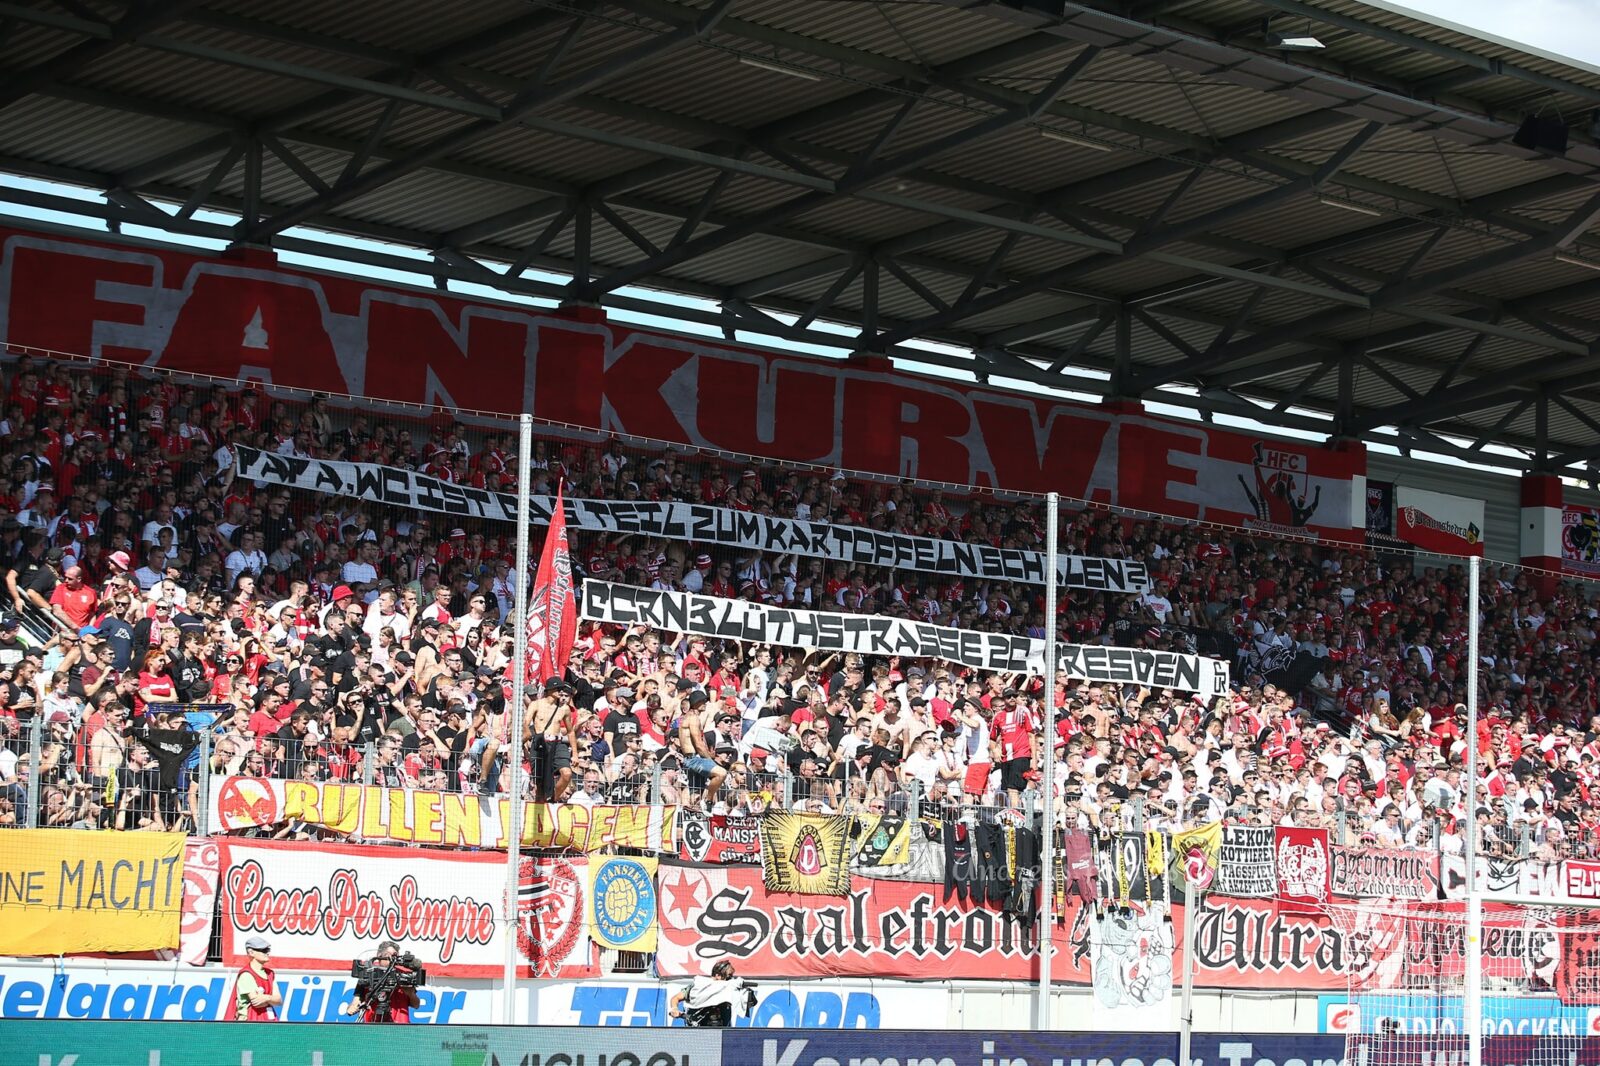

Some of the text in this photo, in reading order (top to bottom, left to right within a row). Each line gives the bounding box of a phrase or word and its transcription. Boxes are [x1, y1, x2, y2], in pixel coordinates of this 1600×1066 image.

[5, 236, 1208, 514] FANKURVE
[1267, 450, 1299, 470] HFC
[582, 500, 687, 537] TEIL
[690, 506, 760, 546] ZUM
[981, 546, 1147, 591] SCHLEN?
[58, 857, 181, 910] MACHT
[323, 868, 385, 940] Per
[385, 874, 496, 963] Sempre
[0, 974, 227, 1020] elgard
